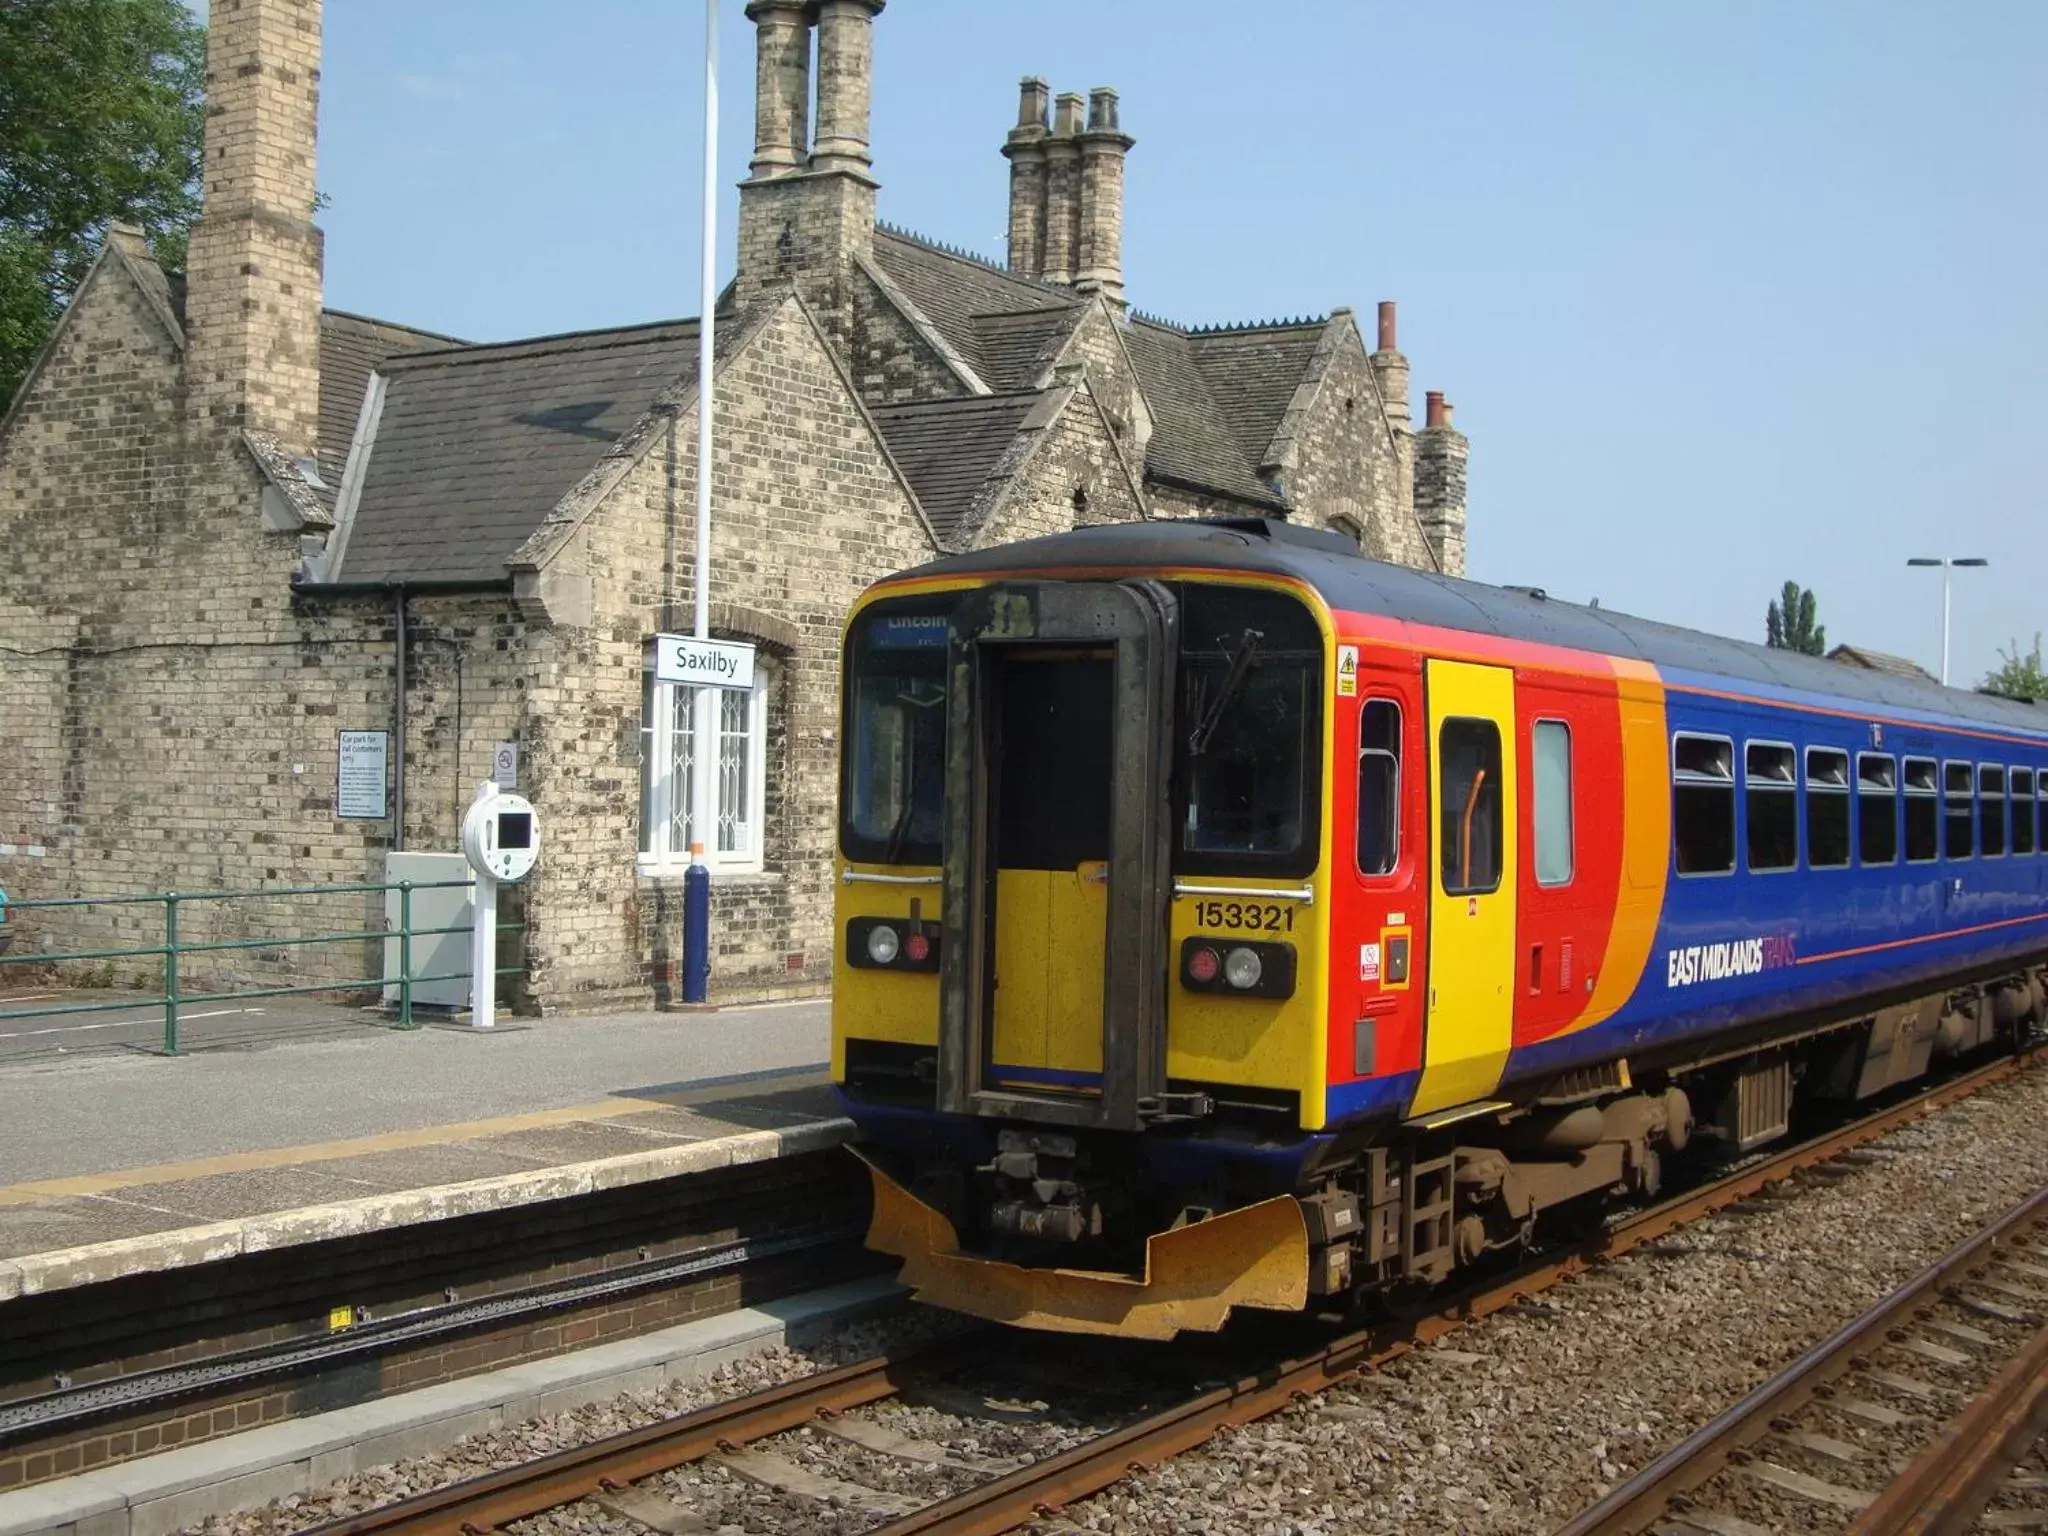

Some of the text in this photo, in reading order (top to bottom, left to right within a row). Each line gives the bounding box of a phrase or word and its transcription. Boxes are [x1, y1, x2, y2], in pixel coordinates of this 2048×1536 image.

[676, 647, 738, 678] Saxilby
[1195, 902, 1294, 932] 153321
[1668, 946, 1701, 988] EAST
[1700, 938, 1763, 982] MIDLANDS
